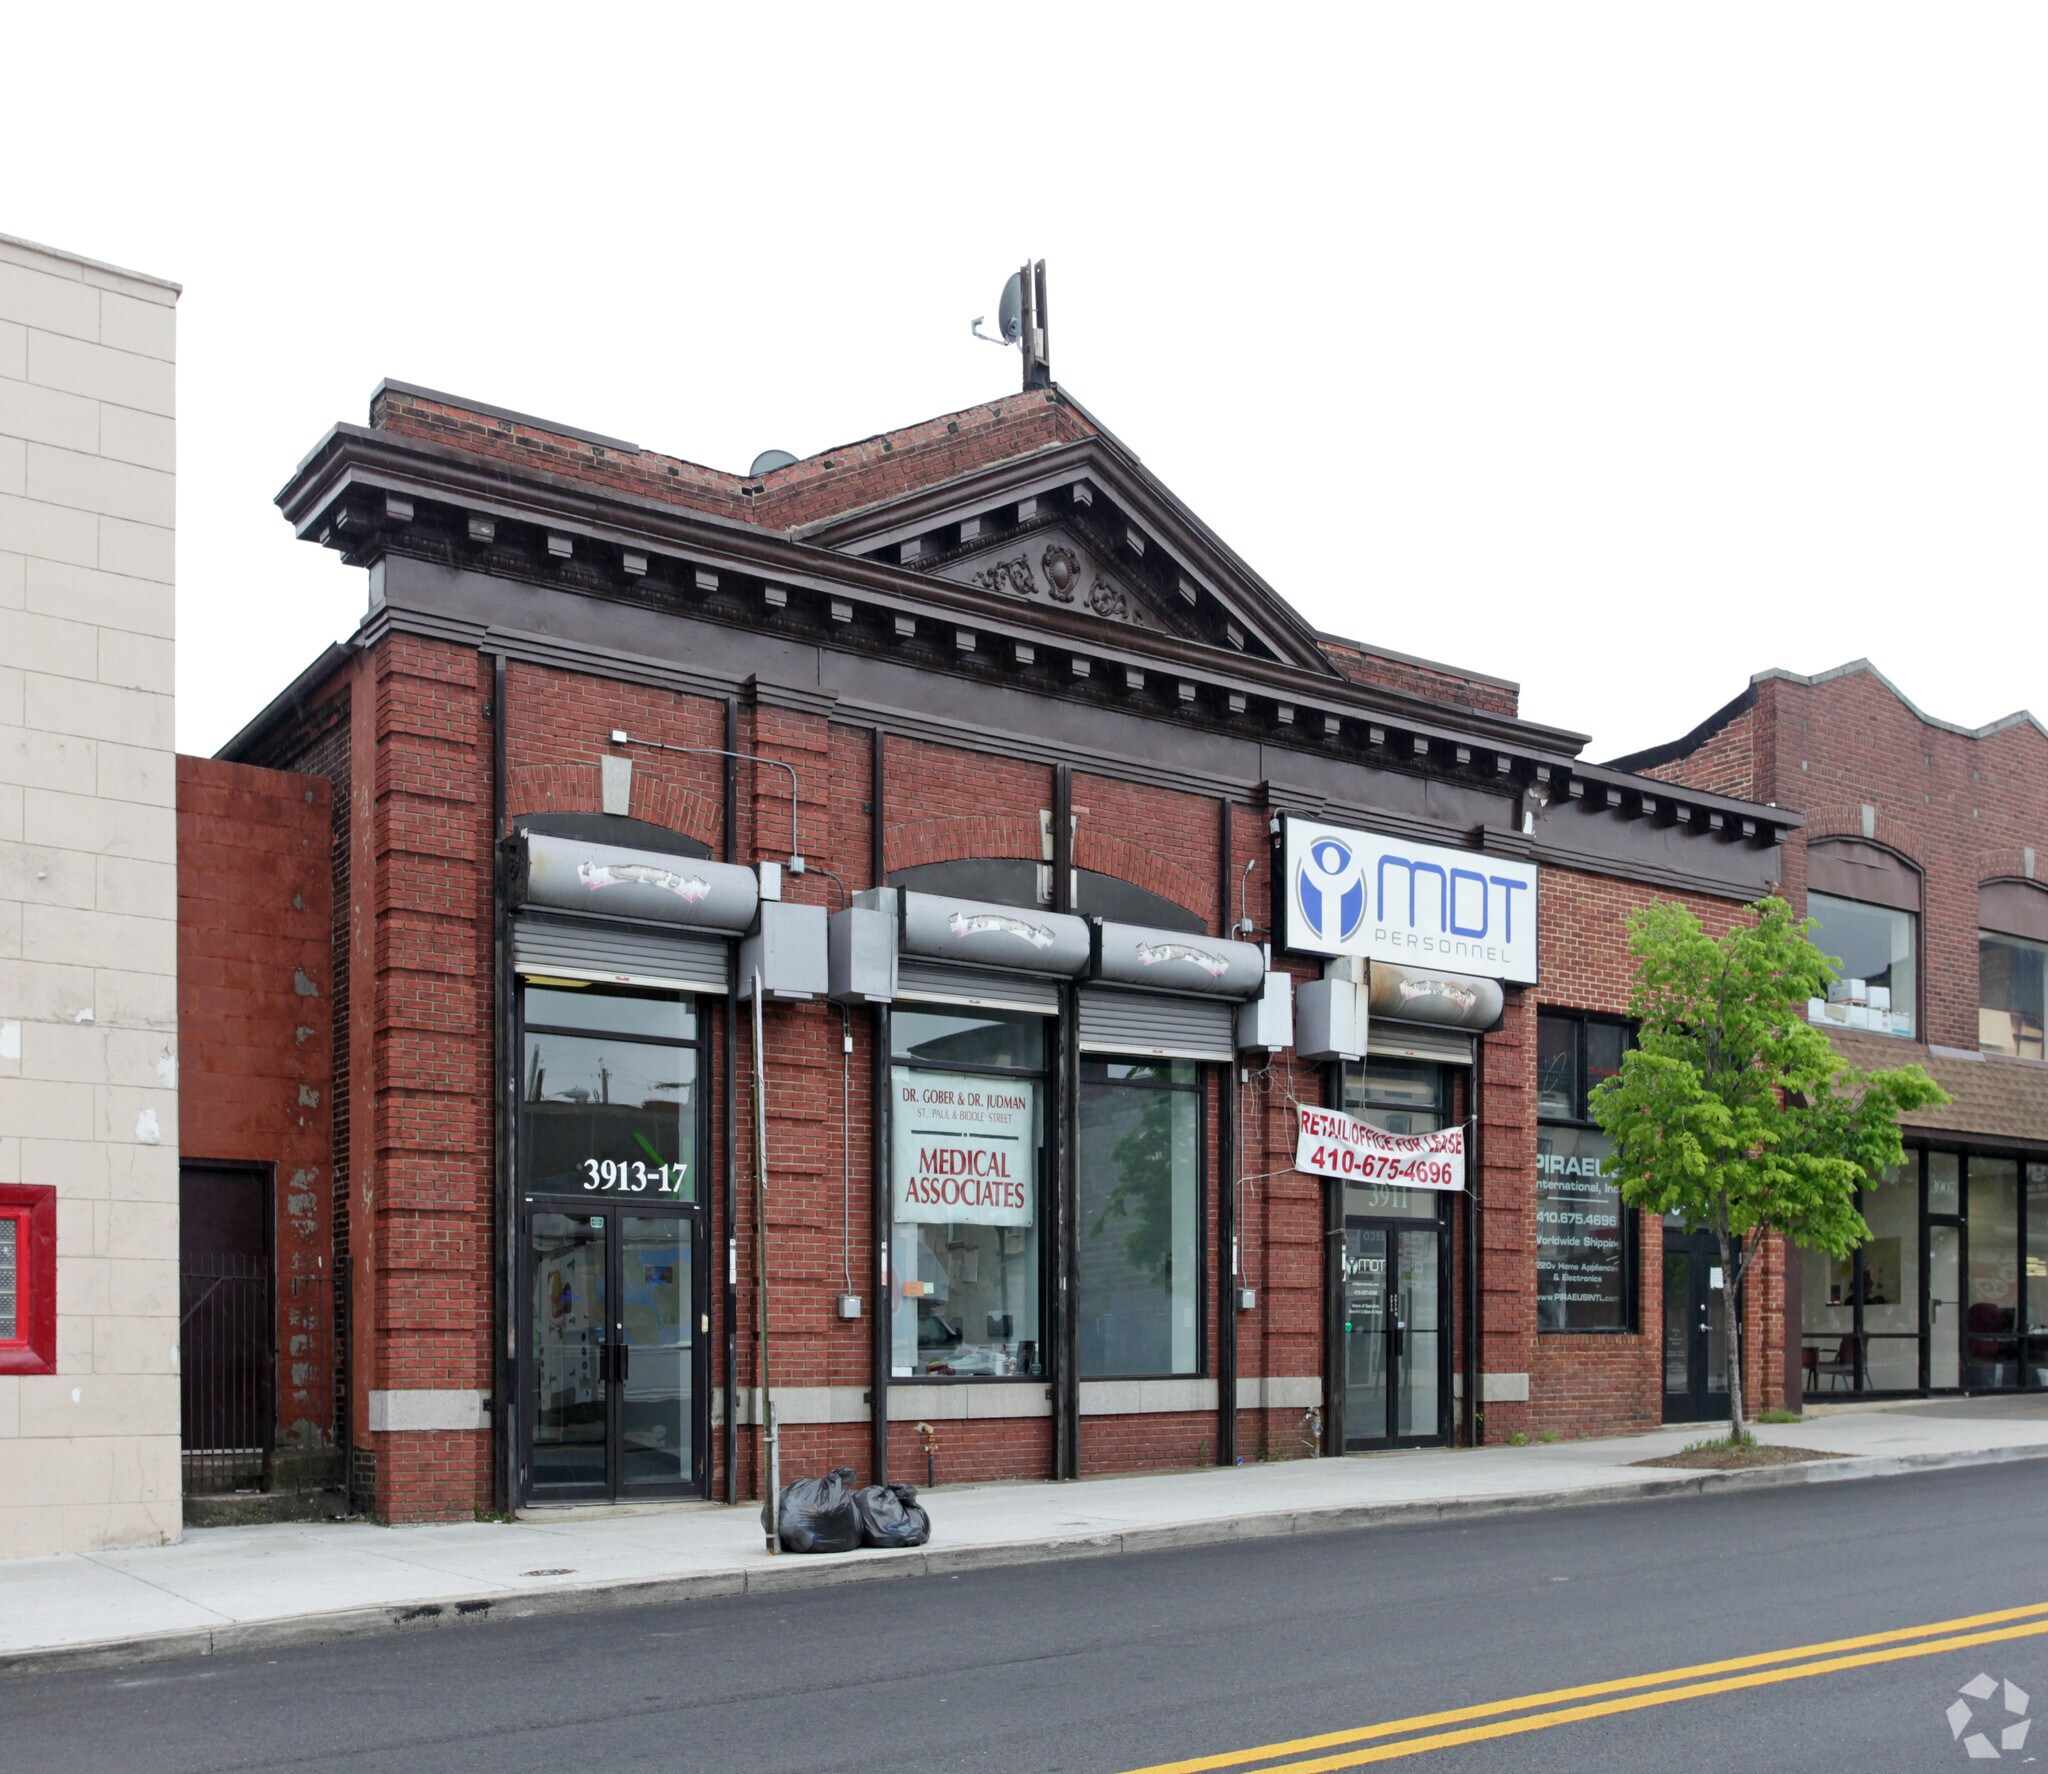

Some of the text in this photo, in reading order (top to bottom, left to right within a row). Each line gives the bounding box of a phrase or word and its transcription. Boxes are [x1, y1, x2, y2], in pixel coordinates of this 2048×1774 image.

[1377, 854, 1528, 944] MDT
[1375, 928, 1511, 963] PERSONNEL
[902, 1088, 1026, 1110] DR. GOBER & DR. JUDMAN
[917, 1108, 1013, 1124] ST. PAUL & BIDDLE STREET
[1396, 1136, 1423, 1152] FOR
[1424, 1133, 1463, 1155] LEASE
[583, 1158, 688, 1193] 3913-17
[918, 1147, 1011, 1178] MEDICAL
[1311, 1146, 1452, 1185] 410-675-4696
[905, 1176, 1025, 1209] ASSOCIATES
[1368, 1183, 1408, 1209] 3911
[1536, 1211, 1617, 1227] 410.675.4696
[1553, 1273, 1602, 1283] & Electronics
[1558, 1262, 1579, 1271] Home
[1581, 1263, 1619, 1273] Appliances
